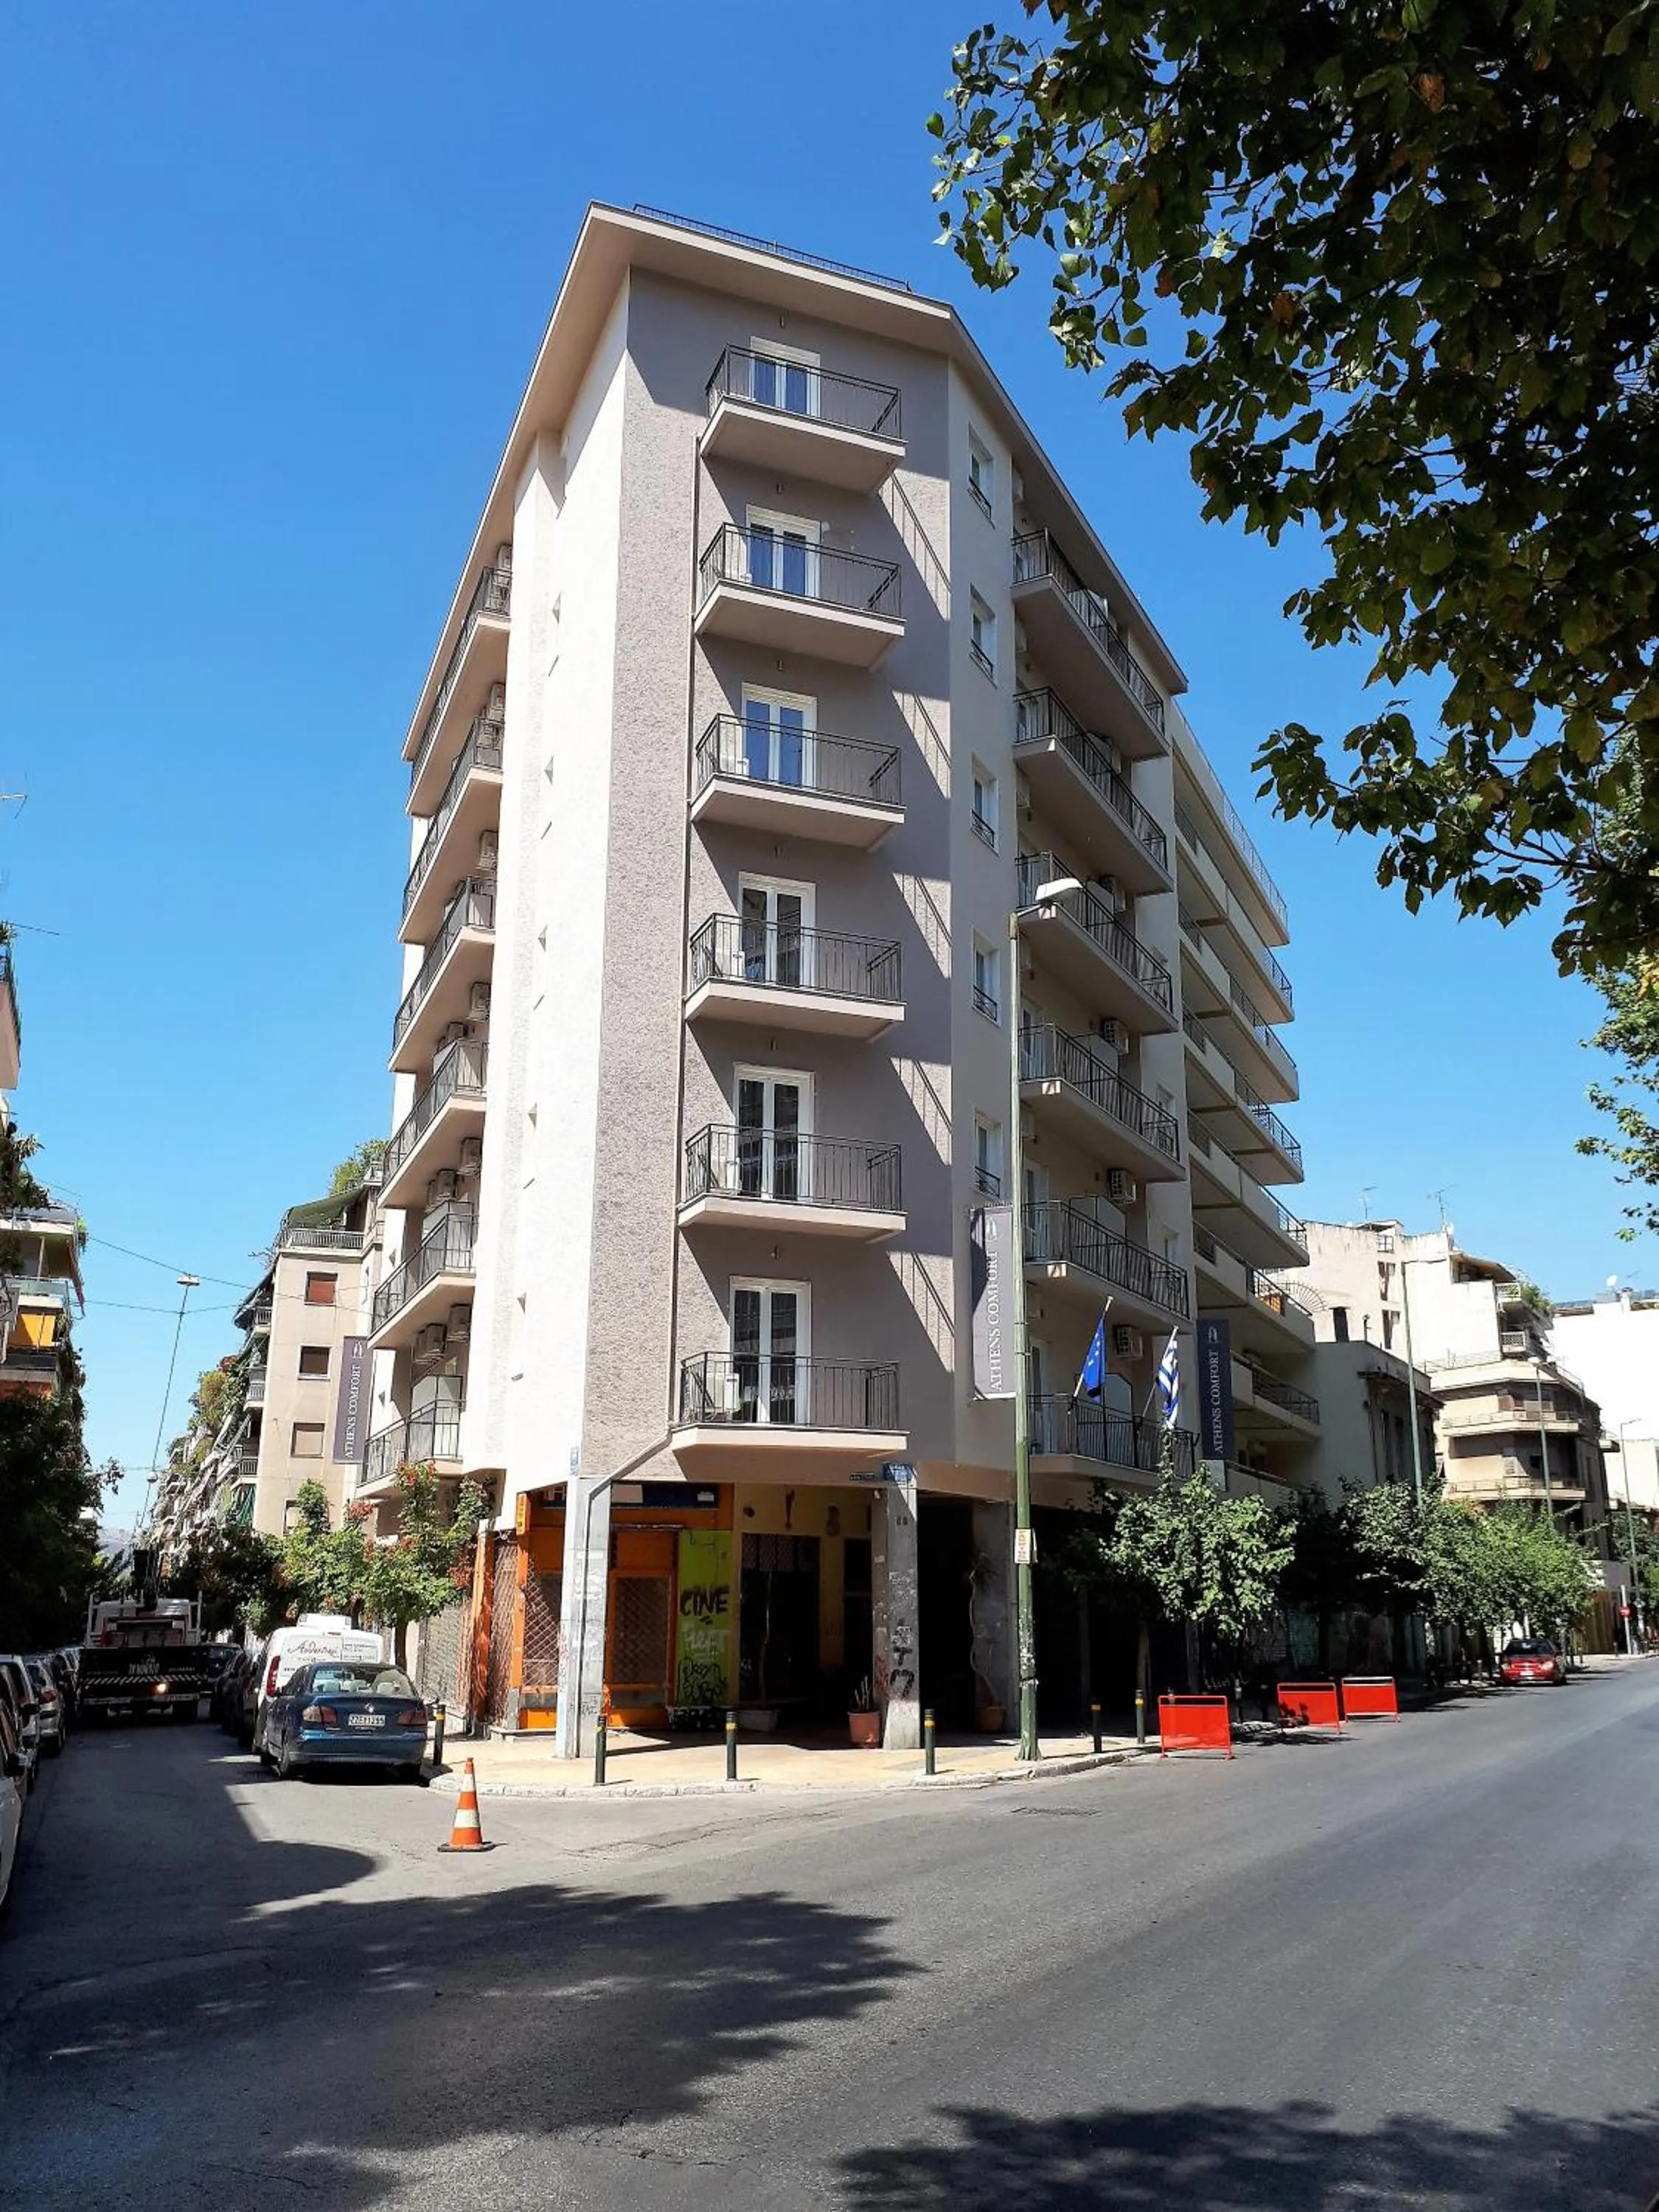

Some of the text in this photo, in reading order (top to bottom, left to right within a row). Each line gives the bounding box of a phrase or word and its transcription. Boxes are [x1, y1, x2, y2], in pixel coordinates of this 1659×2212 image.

[990, 1327, 1002, 1391] ATHENS
[344, 1364, 361, 1460] ATHENS COMFORT
[1209, 1349, 1223, 1453] ATHENS COMFORT
[681, 1587, 729, 1616] CINE
